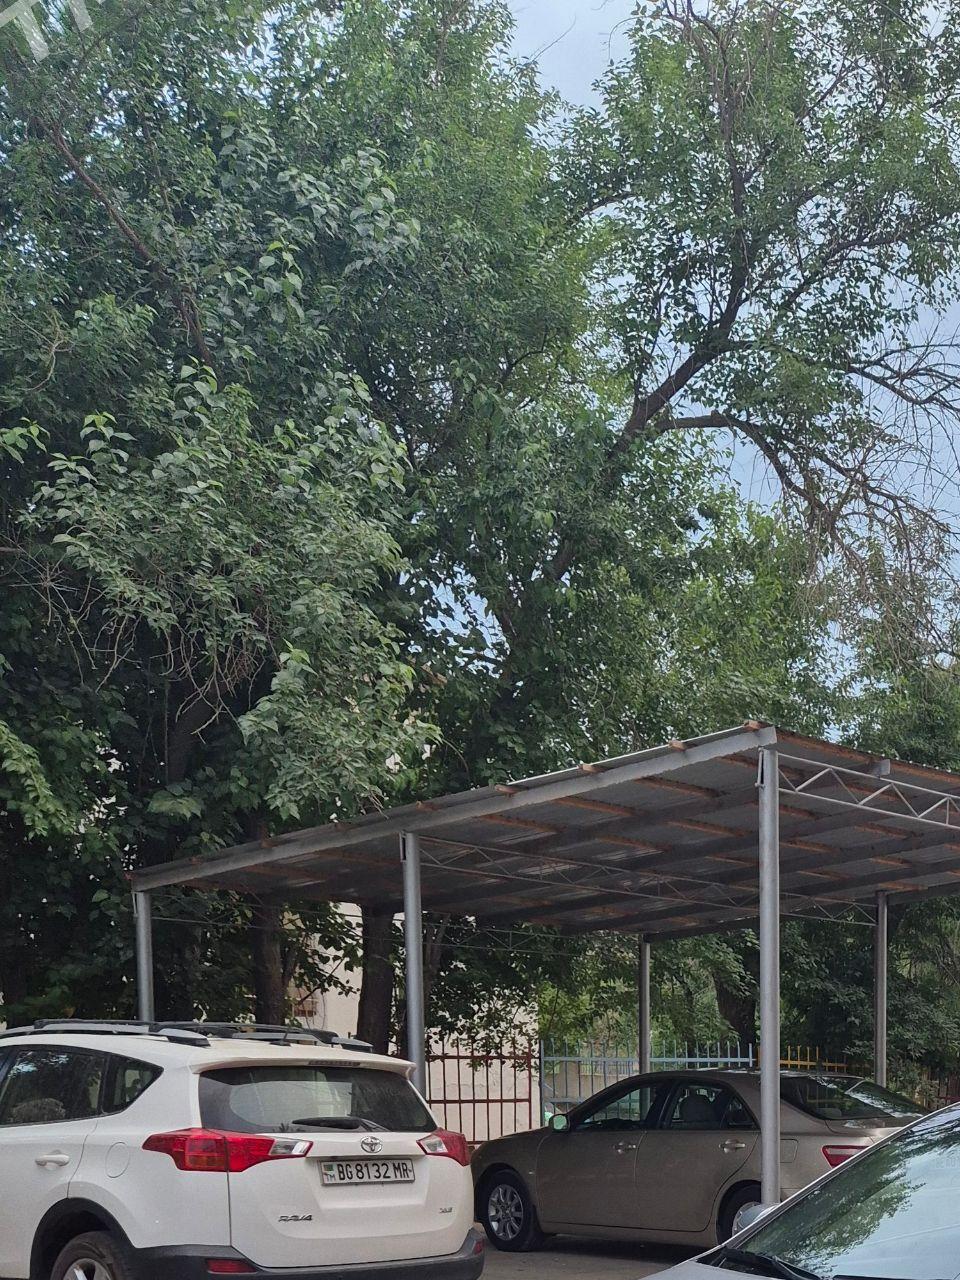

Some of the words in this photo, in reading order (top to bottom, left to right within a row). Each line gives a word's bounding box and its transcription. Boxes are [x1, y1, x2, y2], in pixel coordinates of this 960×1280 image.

[337, 1163, 353, 1180] BG
[355, 1162, 391, 1179] 8132
[393, 1162, 409, 1178] MR
